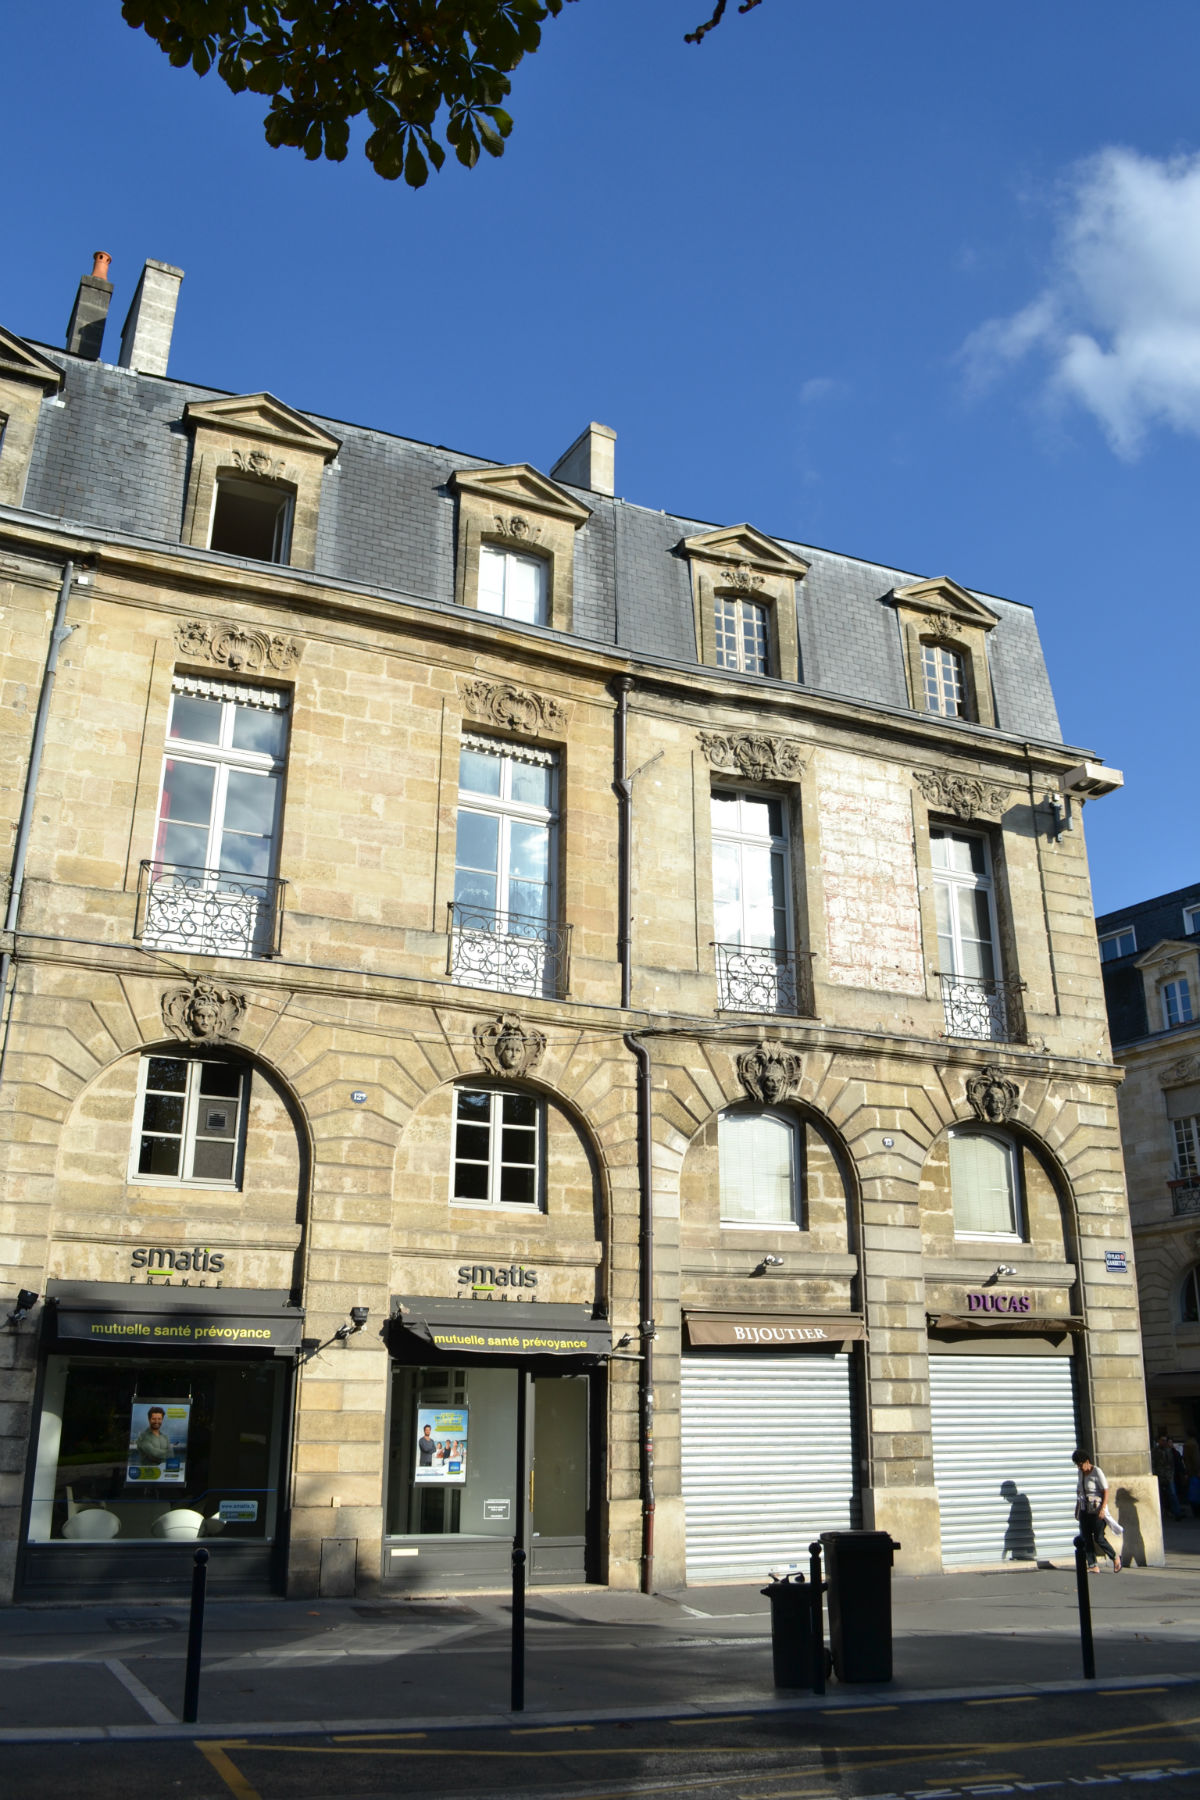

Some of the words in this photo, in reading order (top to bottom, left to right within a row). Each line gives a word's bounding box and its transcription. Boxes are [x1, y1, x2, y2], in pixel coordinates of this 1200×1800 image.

[131, 1247, 225, 1273] smatis
[130, 1275, 223, 1290] FRANCE
[457, 1265, 539, 1288] smatis
[457, 1291, 537, 1303] FRANCE
[967, 1293, 1031, 1313] DUCAS
[91, 1323, 151, 1336] mutuelle
[153, 1324, 192, 1337] santé
[194, 1325, 272, 1340] prévoyance
[733, 1326, 829, 1344] BIJOUTIER
[434, 1334, 486, 1346] mutuelle
[487, 1336, 520, 1347] santé
[522, 1337, 588, 1351] prévoyance
